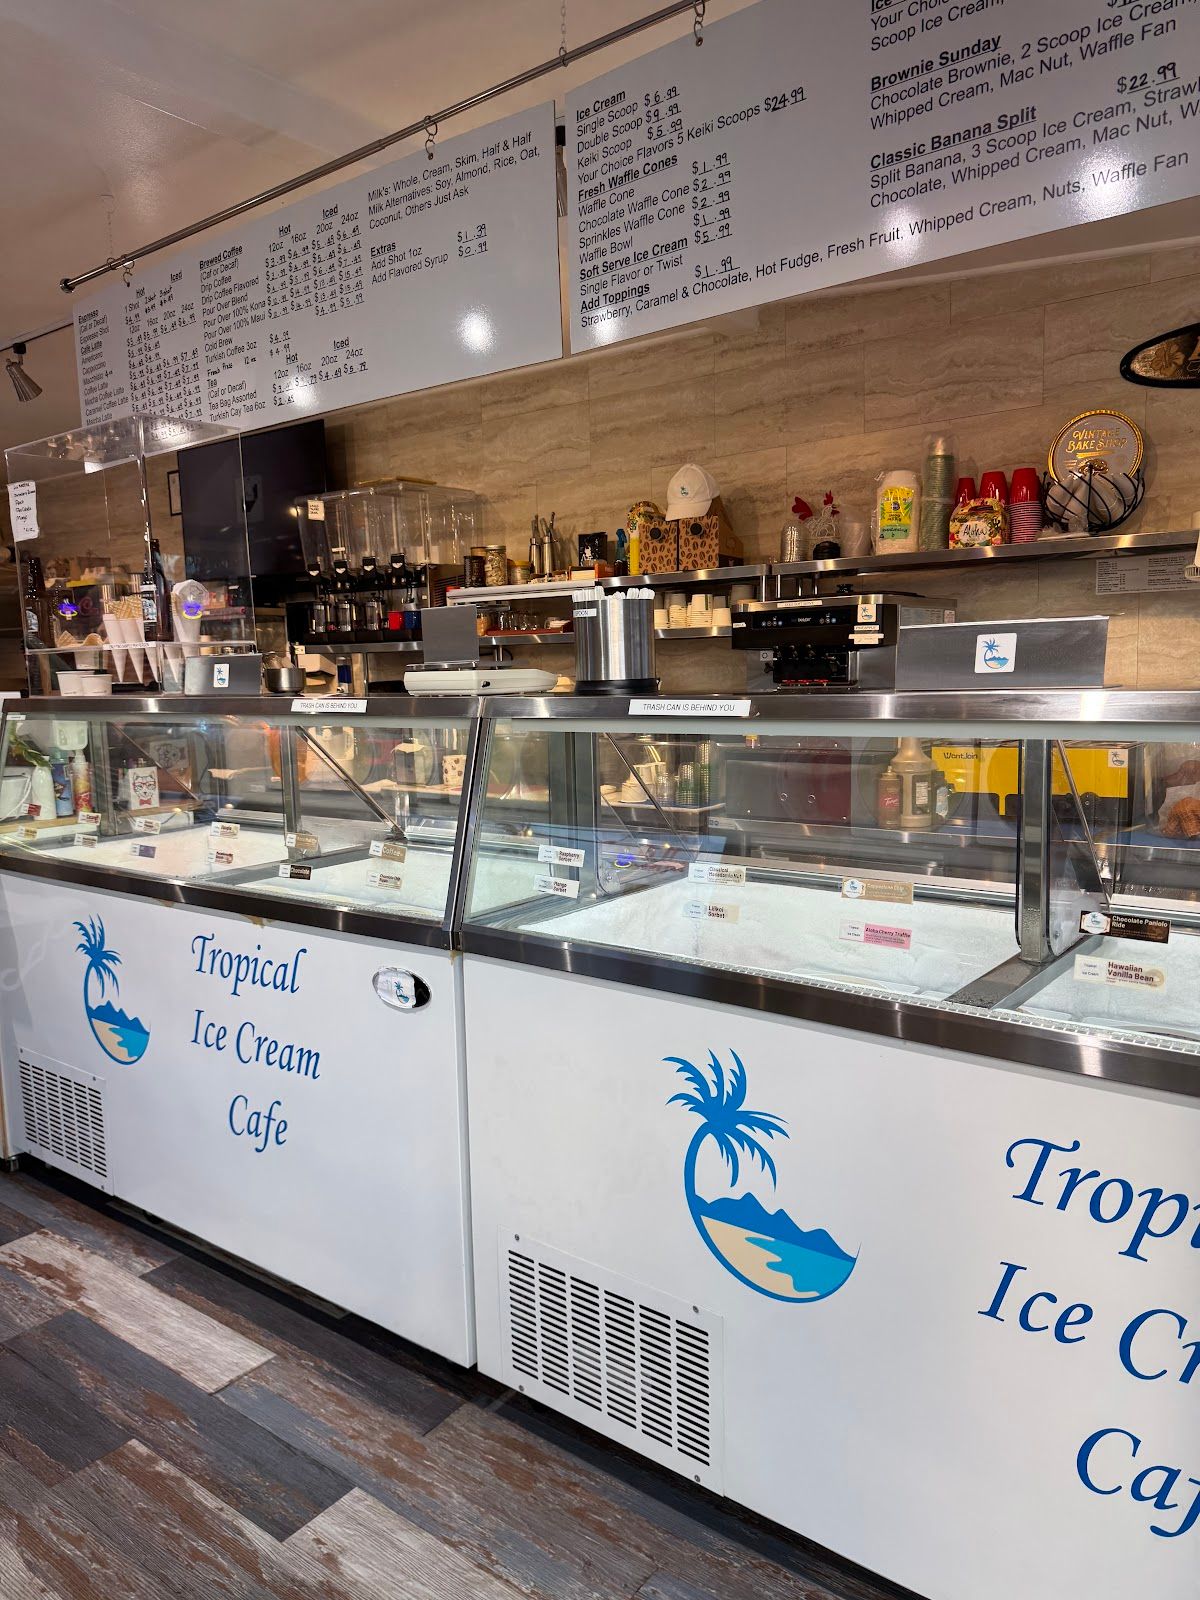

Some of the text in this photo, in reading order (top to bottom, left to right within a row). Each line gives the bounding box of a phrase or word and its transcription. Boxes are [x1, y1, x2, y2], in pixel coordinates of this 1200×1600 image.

[871, 18, 942, 51] Scoop Ice
[872, 12, 903, 31] Your
[871, 15, 1123, 110] Chocolate Brownie, 2 Scoop Ice
[871, 35, 1001, 92] Brownie Sunday
[871, 19, 1176, 130] Whipped Cream, Mac Nut, Waffle Fan
[576, 90, 625, 121] Ice Cream
[576, 117, 604, 137] Single
[608, 102, 638, 124] Scoop
[871, 62, 1180, 170] Classic Banana Split $22.99
[577, 131, 608, 153] Double
[611, 117, 643, 139] Scoop
[577, 150, 599, 170] Keiki
[602, 138, 632, 159] Scoop
[578, 167, 598, 185] Your
[601, 154, 634, 175] Choice
[637, 138, 674, 160] Flavors
[677, 132, 684, 145] 5
[687, 121, 714, 141] Keiki
[717, 103, 760, 129] Scoops
[871, 100, 1136, 189] Split Banana, 3 Scoop Ice Cream,
[368, 132, 532, 202] Milk's: Whole, Cream, Skim, Half & Half
[578, 154, 678, 202] Fresh Waffle Cones
[871, 111, 1173, 208] Chocolate, Whipped Cream, Mac Nut,
[368, 146, 540, 216] Milk Alternatives: Soy, Almond, Rice, Oat,
[405, 200, 432, 216] Others
[434, 192, 451, 206] Just
[453, 185, 469, 199] Ask
[279, 204, 338, 237] Hot Iced
[578, 187, 634, 217] Waffle Cone
[578, 184, 690, 233] Chocolate Waffle Cone
[579, 203, 685, 249] Sprinkles Waffle Cone
[581, 304, 633, 328] Strawberry,
[636, 288, 678, 312] Caramel
[682, 285, 689, 298] &
[693, 269, 752, 296] Chocolate,
[756, 259, 777, 278] Hot
[780, 247, 823, 273] Fudge,
[827, 236, 864, 260] Fresh
[909, 209, 974, 236] Whipped
[979, 192, 1037, 218] Cream,
[1043, 179, 1086, 201] Nuts,
[1092, 162, 1147, 186] Waffle
[1154, 151, 1189, 173] Fan
[200, 245, 242, 271] Brewed Coffee
[370, 242, 396, 258] Extras
[371, 256, 386, 271] Add
[389, 250, 407, 264] Shot
[409, 247, 423, 258] 1oz
[372, 270, 386, 285] Add
[388, 258, 423, 280] Flavored
[425, 252, 448, 269] Syrup
[579, 237, 633, 265] Waffle Bowl
[580, 236, 688, 281] Soft Serve Ice Cream
[580, 255, 683, 297] Single Flavor or Twist
[581, 283, 650, 313] Add Toppings
[1066, 440, 1095, 453] BAKE
[1112, 915, 1143, 925] Chocolate
[191, 932, 308, 997] Tropical
[1107, 969, 1133, 979] Vanilla
[1134, 974, 1154, 982] Bean
[1108, 962, 1143, 972] Hawaiian
[190, 1009, 322, 1080] Ice Cream
[228, 1094, 289, 1153] Cafe
[977, 1260, 1094, 1345] Ice
